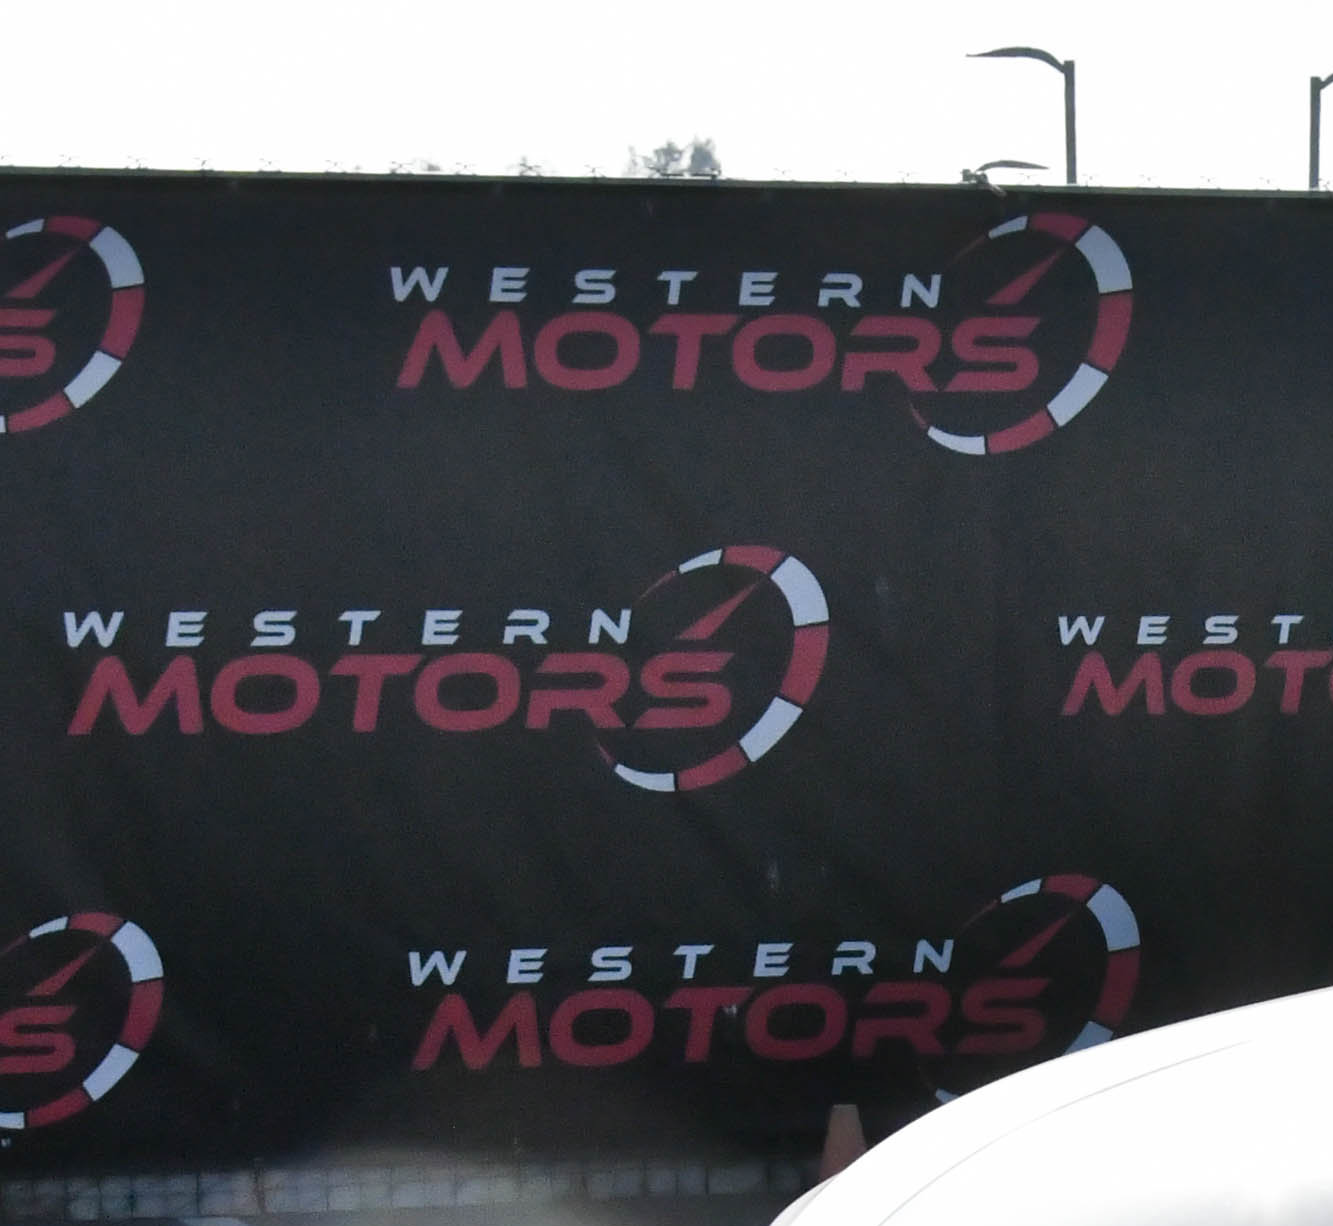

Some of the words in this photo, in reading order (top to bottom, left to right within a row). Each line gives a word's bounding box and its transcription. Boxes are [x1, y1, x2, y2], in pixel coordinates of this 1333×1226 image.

[390, 266, 942, 308] WESTERN
[397, 309, 1041, 392] MOTORS
[63, 608, 633, 648] WESTERN
[67, 651, 734, 736] MOTORS
[407, 939, 955, 986] WESTERN
[411, 976, 1051, 1070] MOTORS
